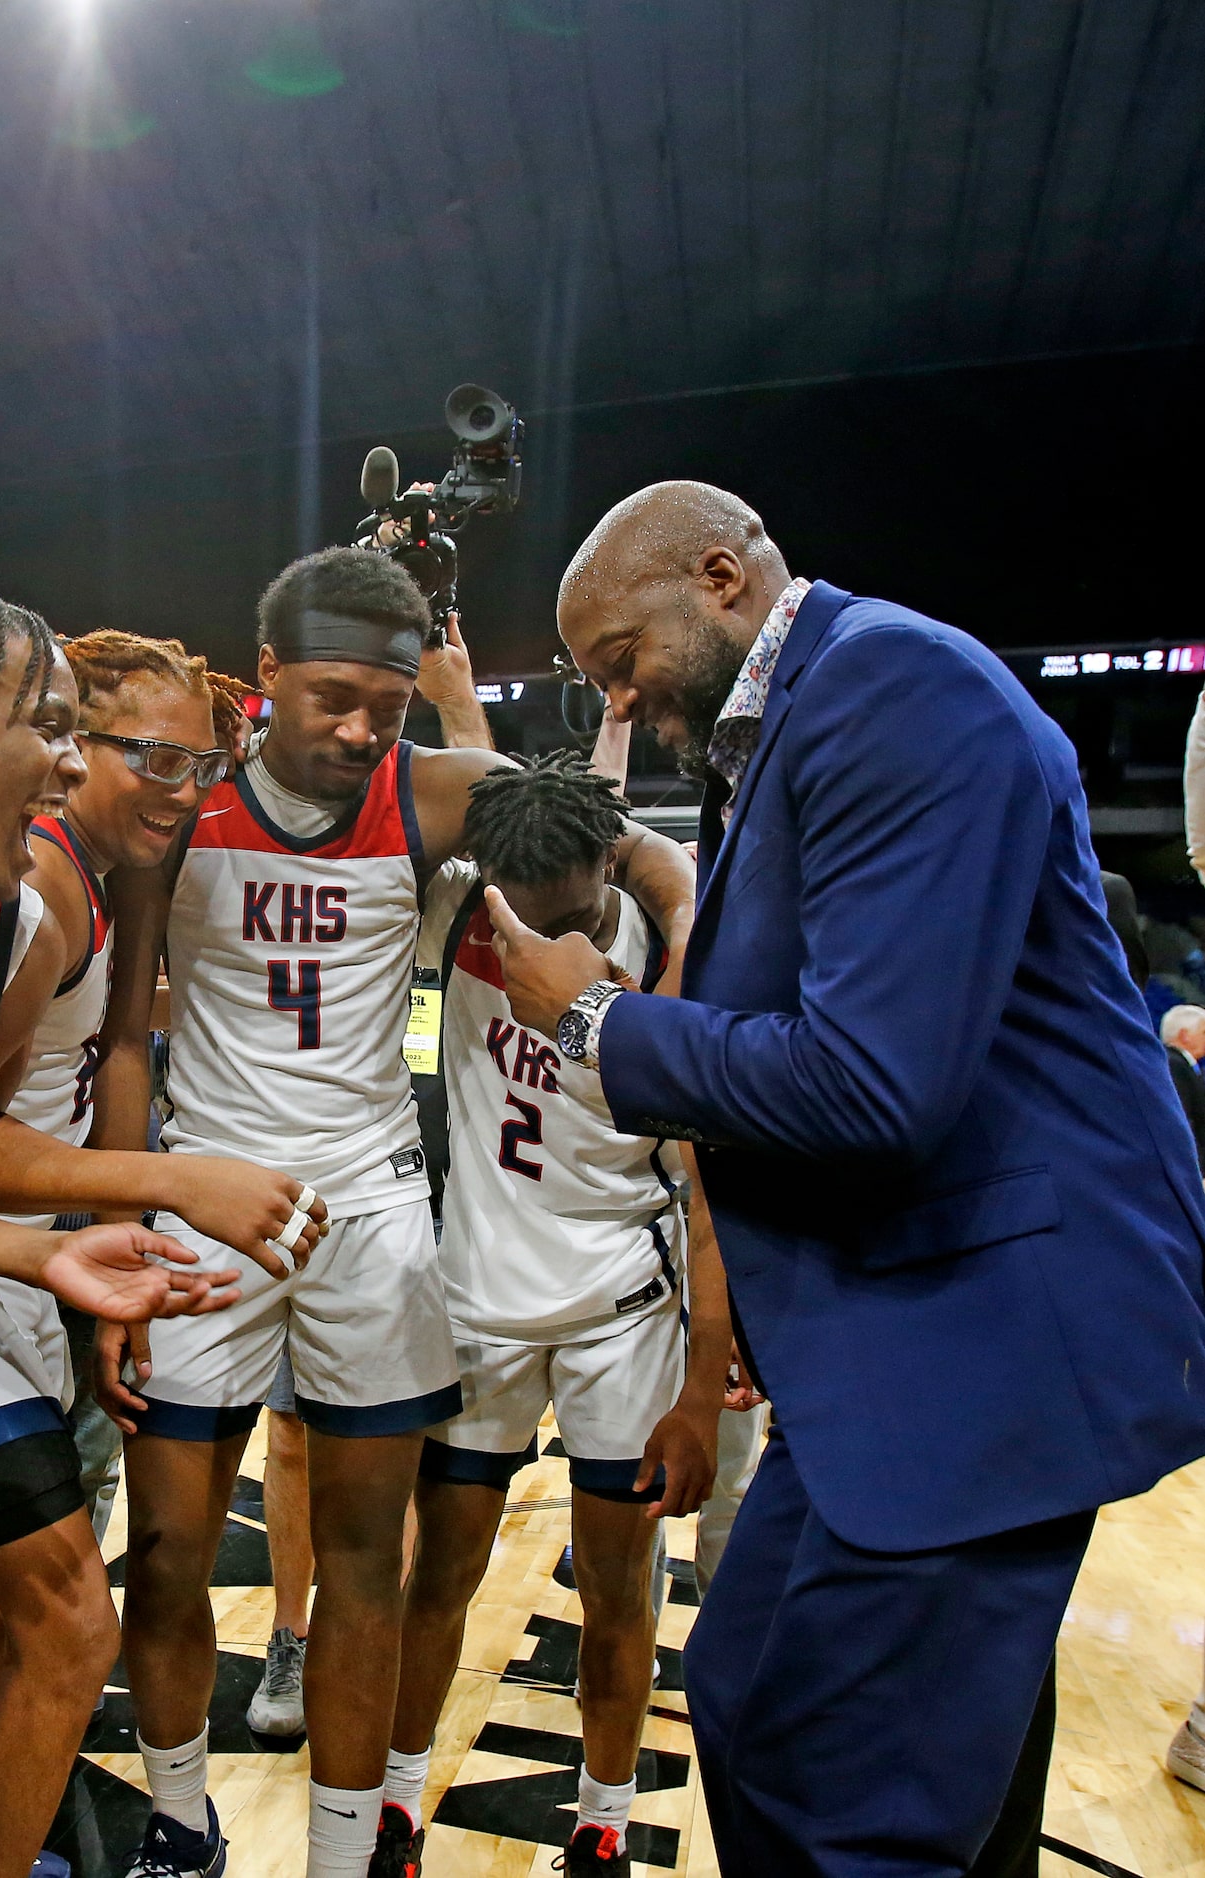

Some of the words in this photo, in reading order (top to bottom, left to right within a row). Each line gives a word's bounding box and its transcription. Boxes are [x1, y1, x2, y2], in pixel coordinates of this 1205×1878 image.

[509, 682, 524, 700] 7
[1143, 650, 1164, 670] 2
[243, 881, 347, 943] KHS
[267, 959, 321, 1050] 4
[486, 1016, 561, 1095] KHS
[499, 1089, 544, 1182] 2
